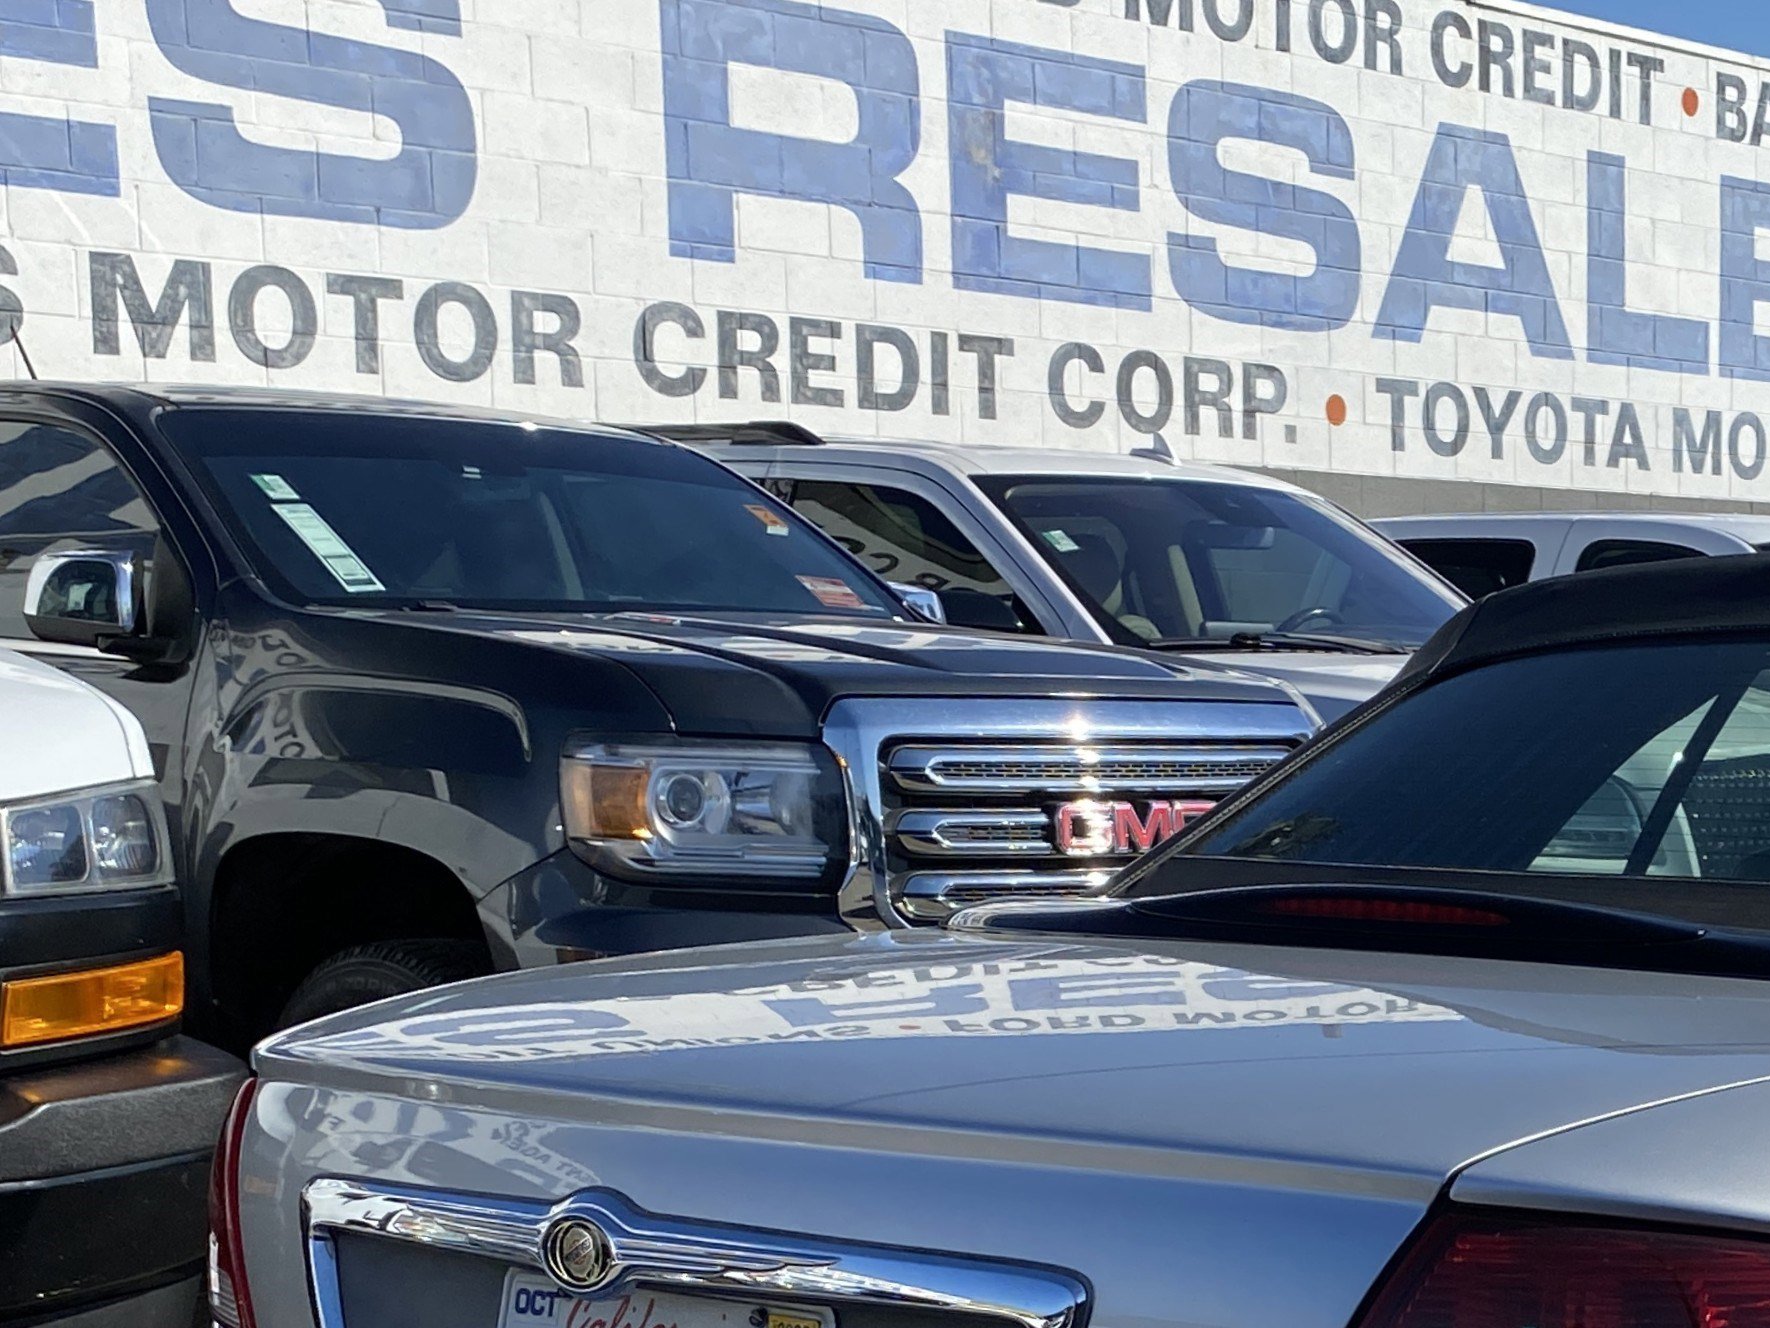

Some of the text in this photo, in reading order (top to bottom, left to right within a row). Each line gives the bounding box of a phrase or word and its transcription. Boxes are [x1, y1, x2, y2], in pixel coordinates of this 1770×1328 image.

[1430, 10, 1665, 126] CREDIT
[88, 250, 585, 388] MOTOR
[633, 300, 1014, 421] CREDIT
[1048, 342, 1297, 444] CORP.
[1376, 377, 1651, 472] TOYOTA
[515, 1288, 558, 1318] OCT
